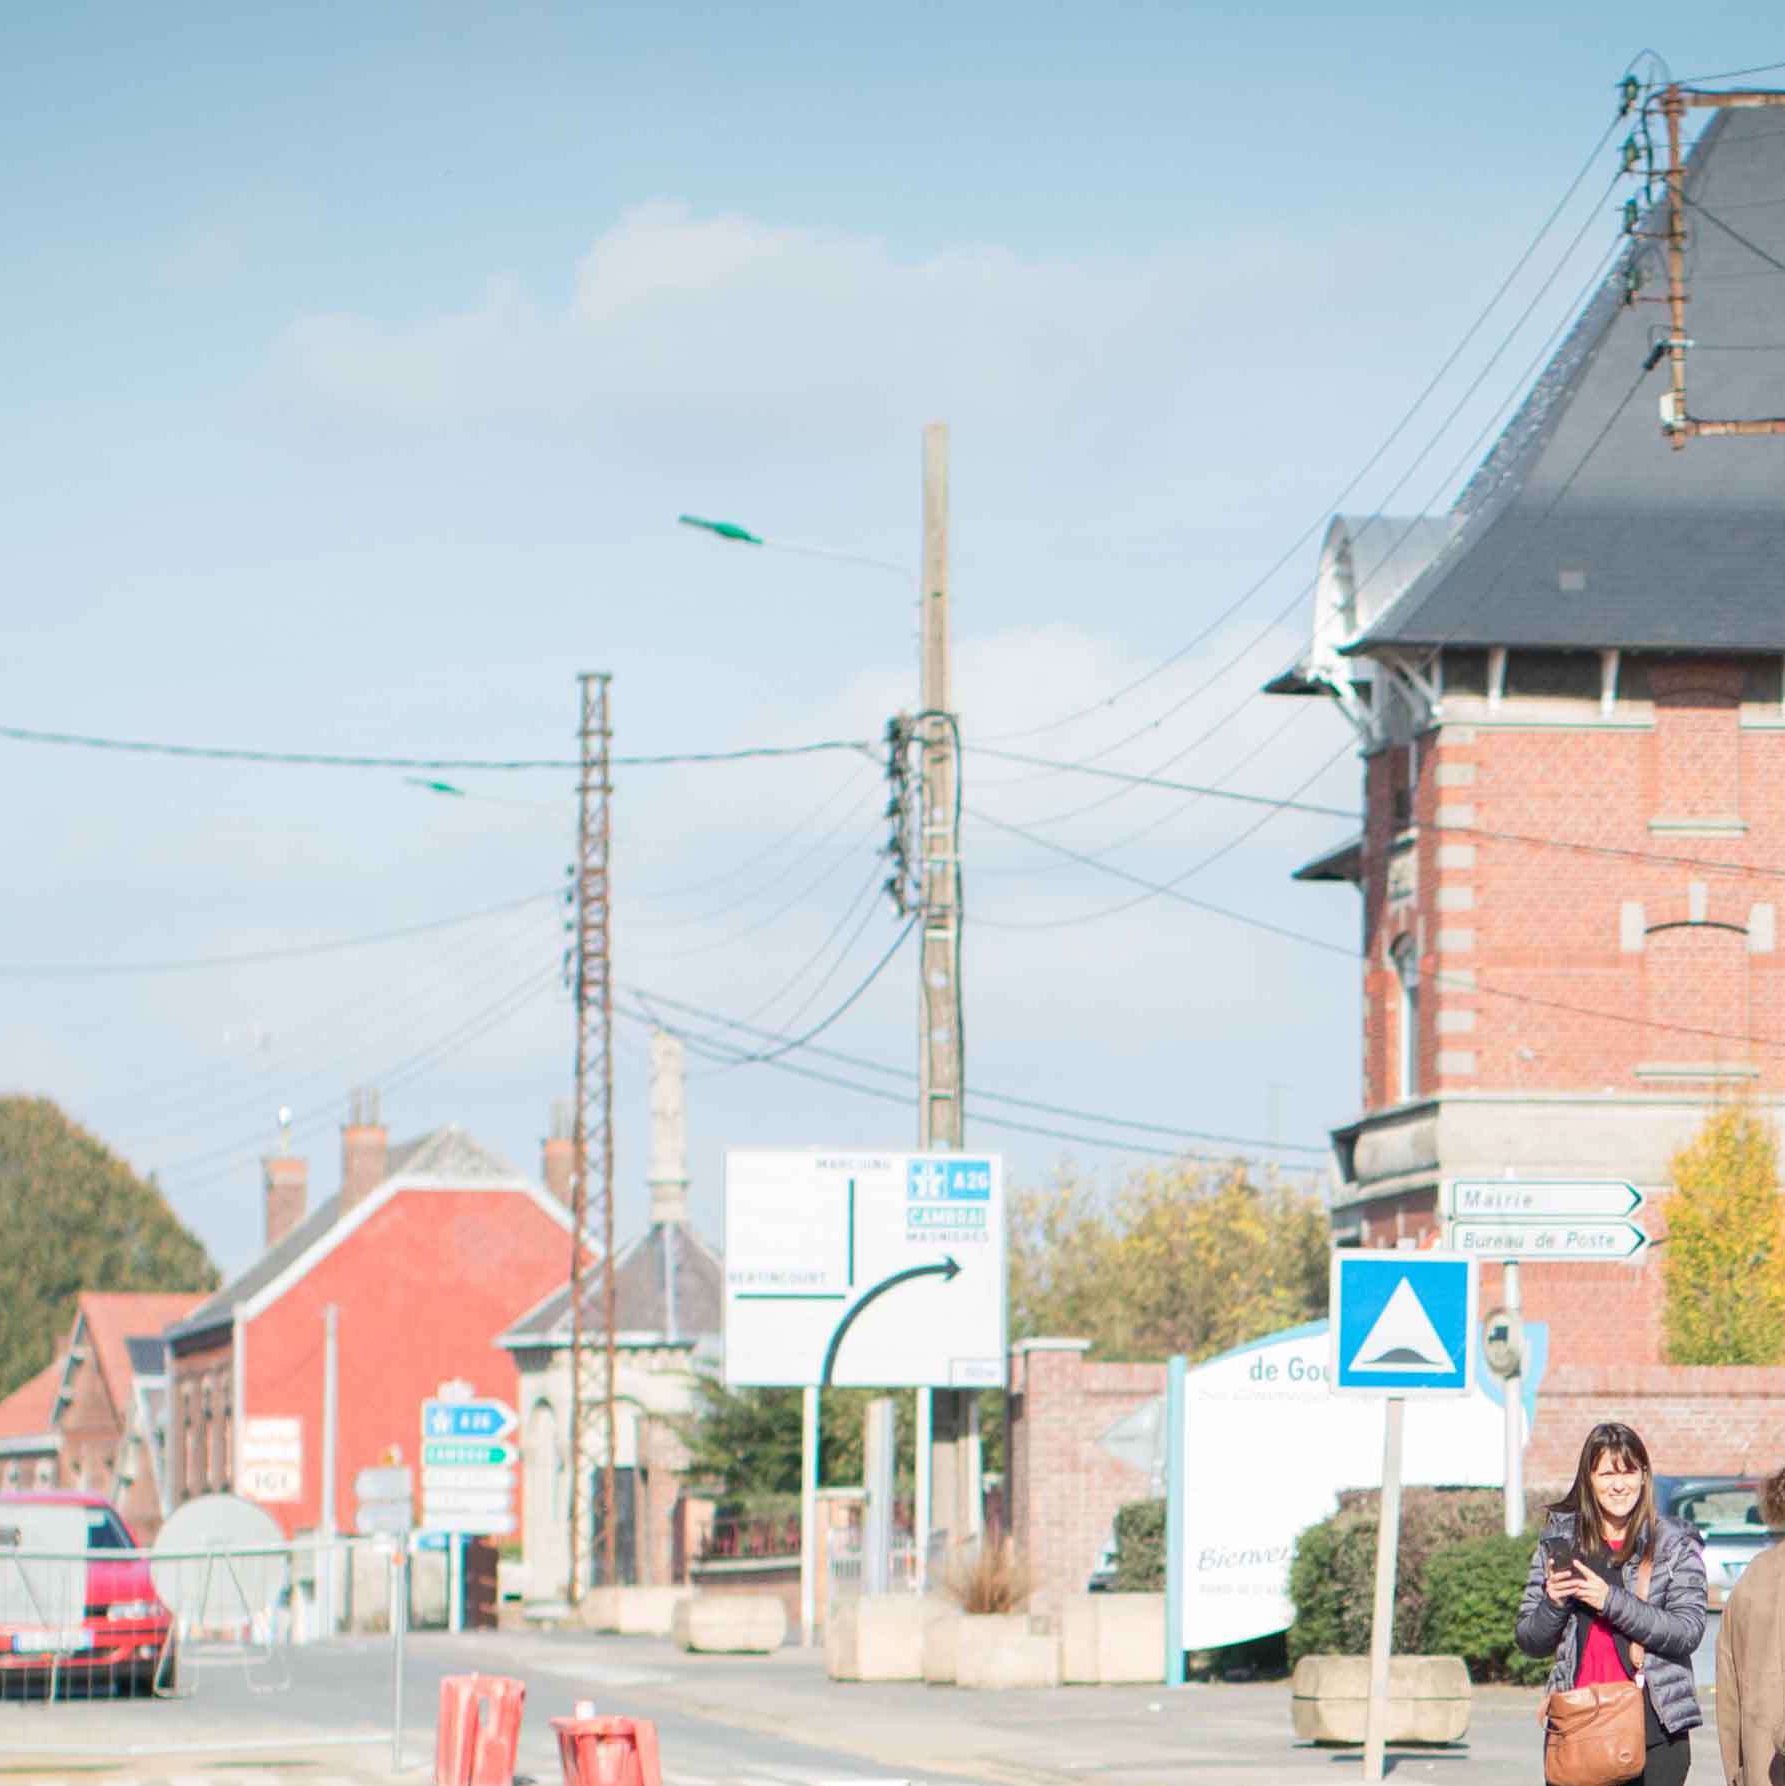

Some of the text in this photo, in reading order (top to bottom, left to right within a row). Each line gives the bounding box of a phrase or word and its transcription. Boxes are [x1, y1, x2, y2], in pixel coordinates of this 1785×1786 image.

[1465, 1190, 1534, 1208] Mairie
[1464, 1231, 1616, 1249] Bureau de Poste
[1249, 1355, 1279, 1382] de
